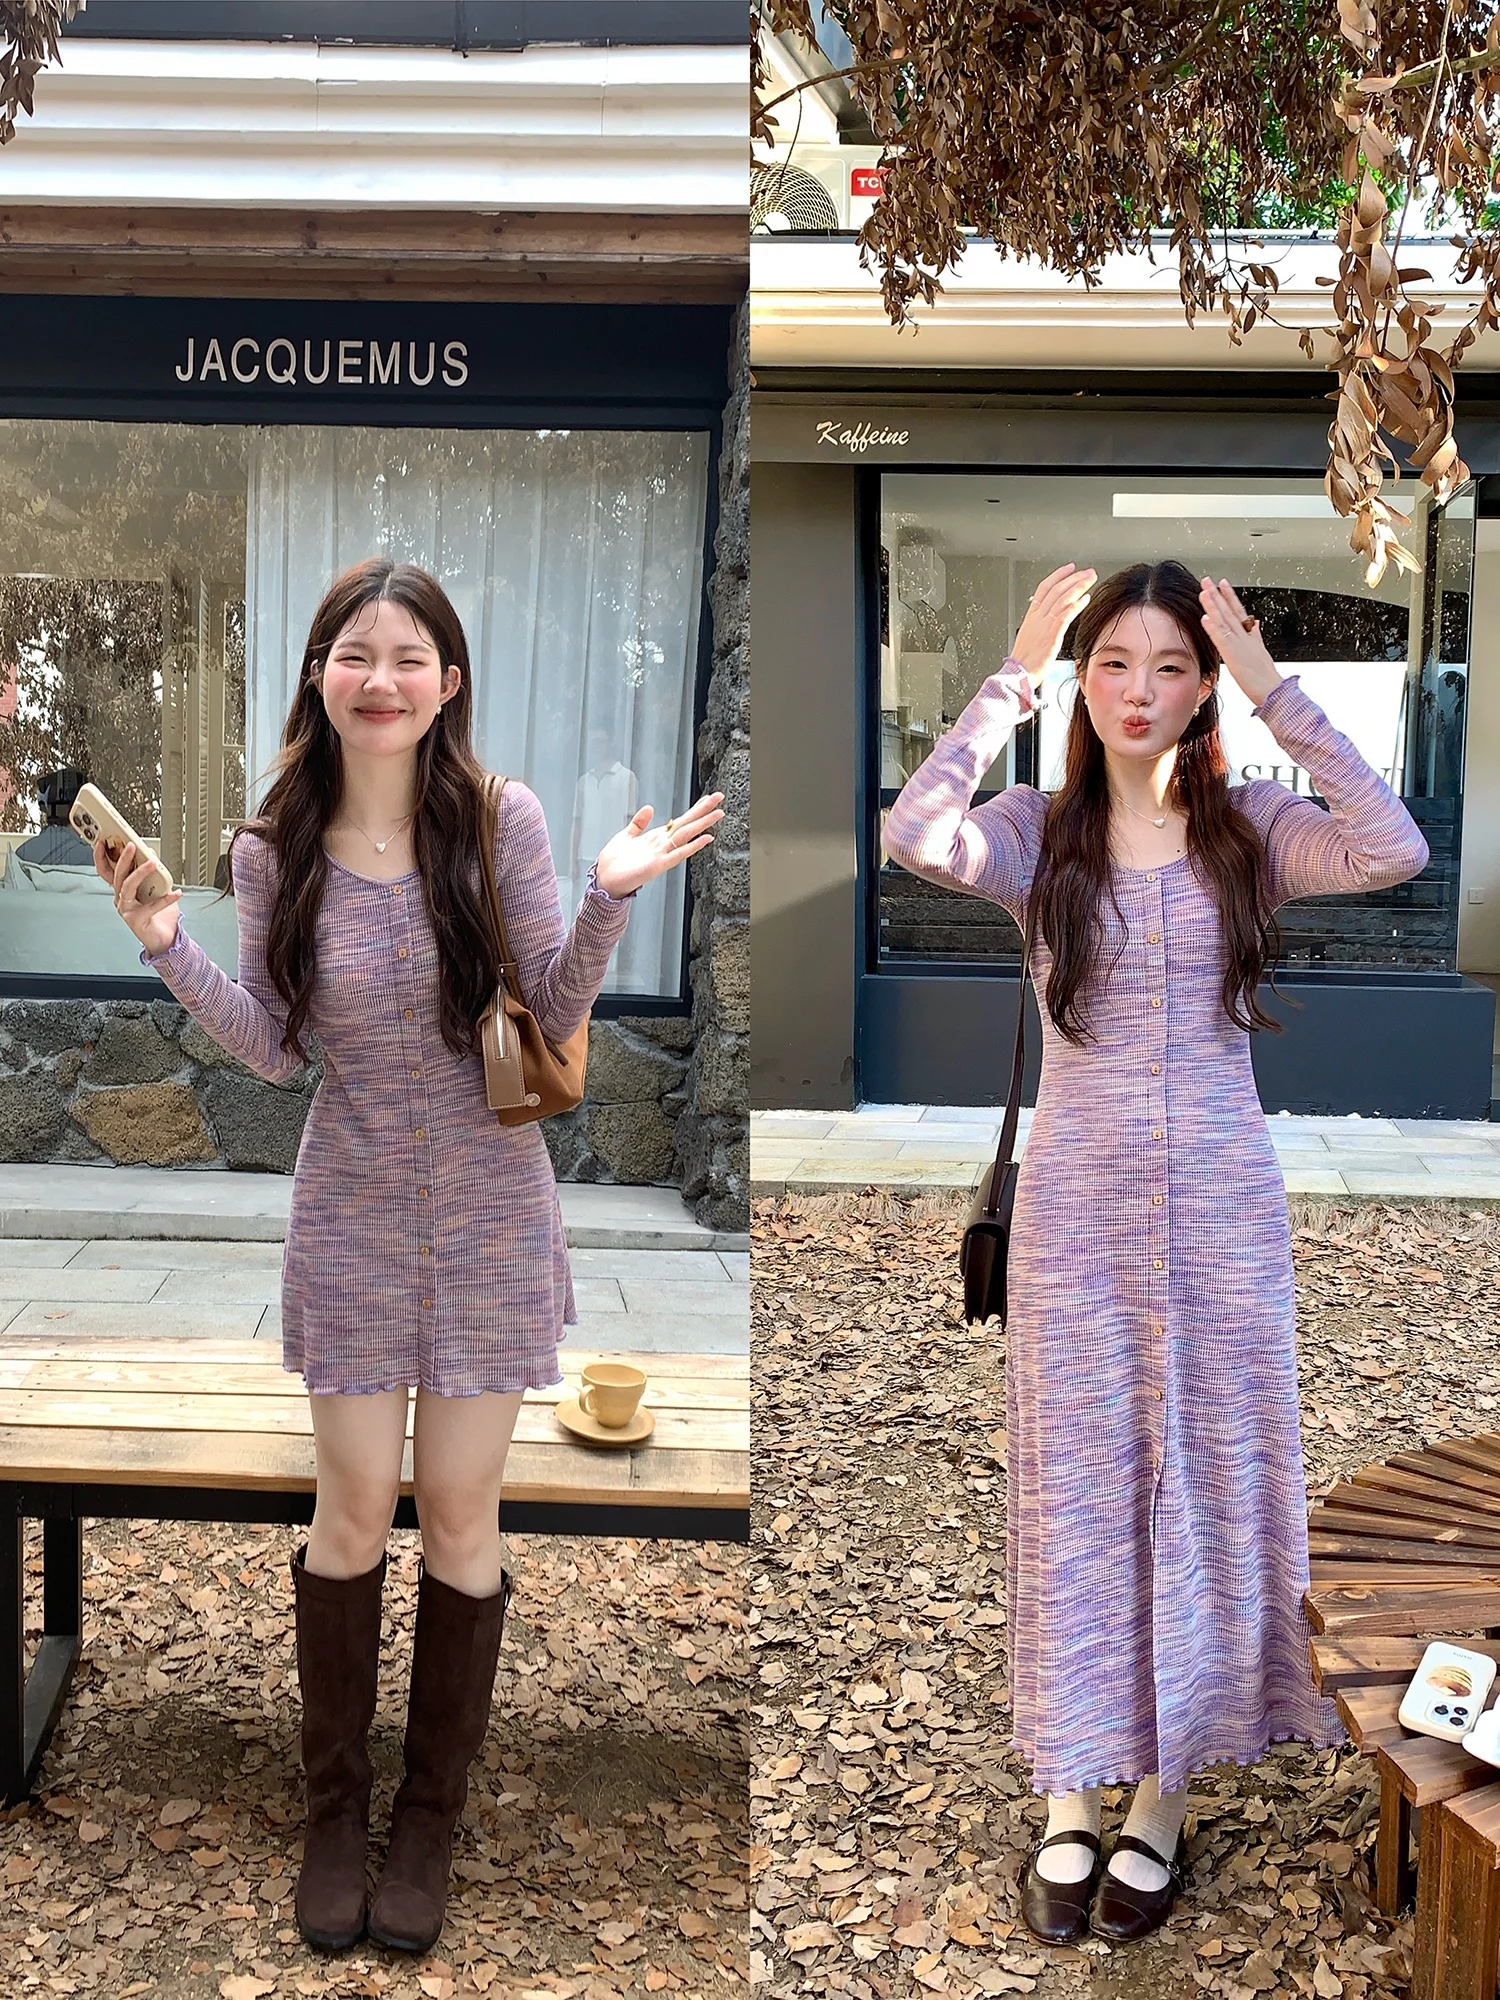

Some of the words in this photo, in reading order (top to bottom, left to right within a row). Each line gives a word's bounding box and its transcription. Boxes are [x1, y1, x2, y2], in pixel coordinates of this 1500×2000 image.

[856, 176, 880, 189] TC
[175, 337, 469, 387] JACQUEMUS
[816, 421, 909, 453] Kaffeine
